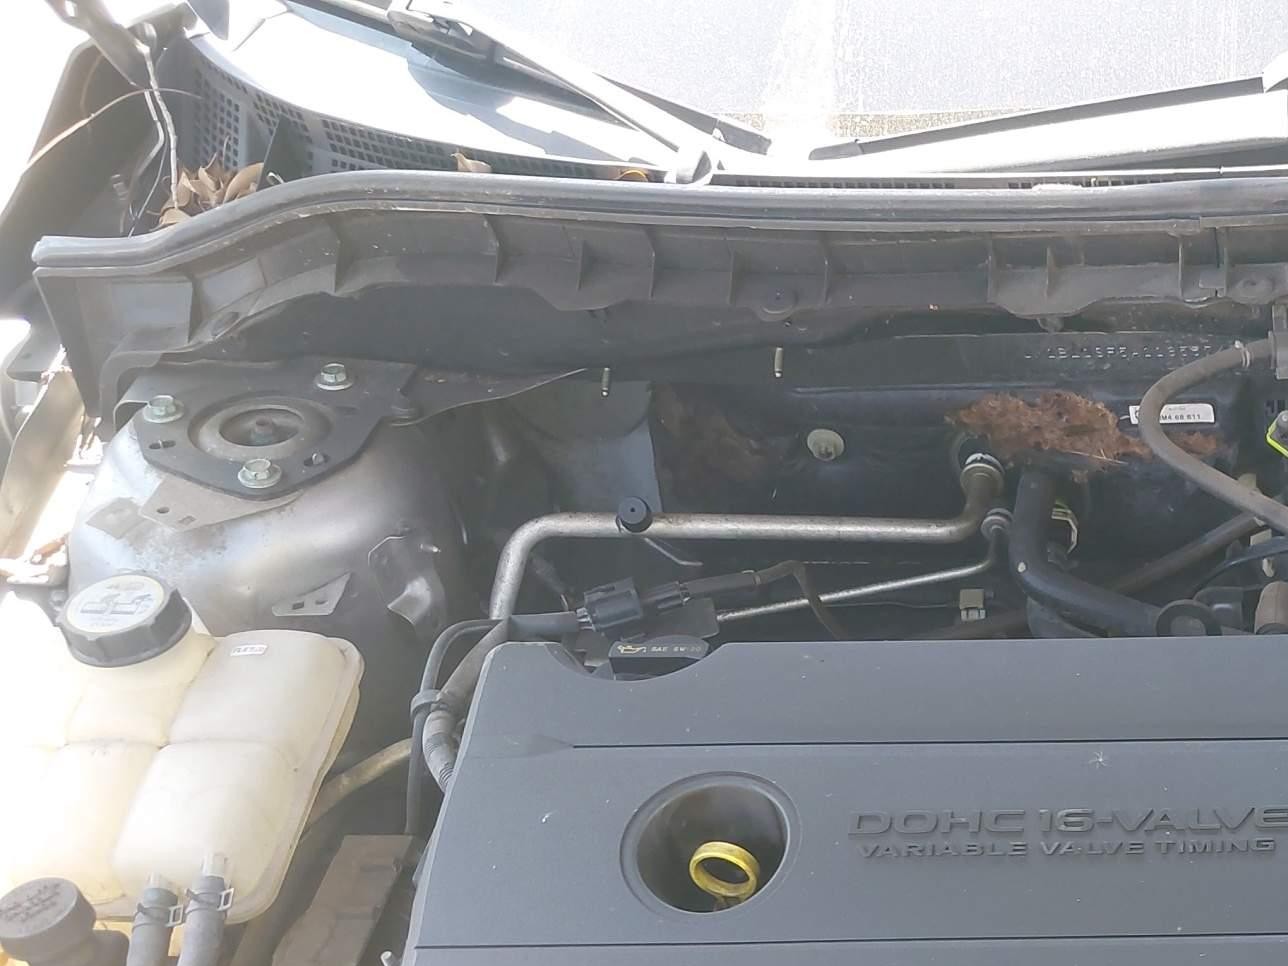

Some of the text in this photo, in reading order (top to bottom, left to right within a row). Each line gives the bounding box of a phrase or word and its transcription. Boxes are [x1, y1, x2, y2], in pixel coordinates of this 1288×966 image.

[848, 809, 1026, 835] DOHC
[860, 837, 1277, 858] VARIABLE VALVE TIMING
